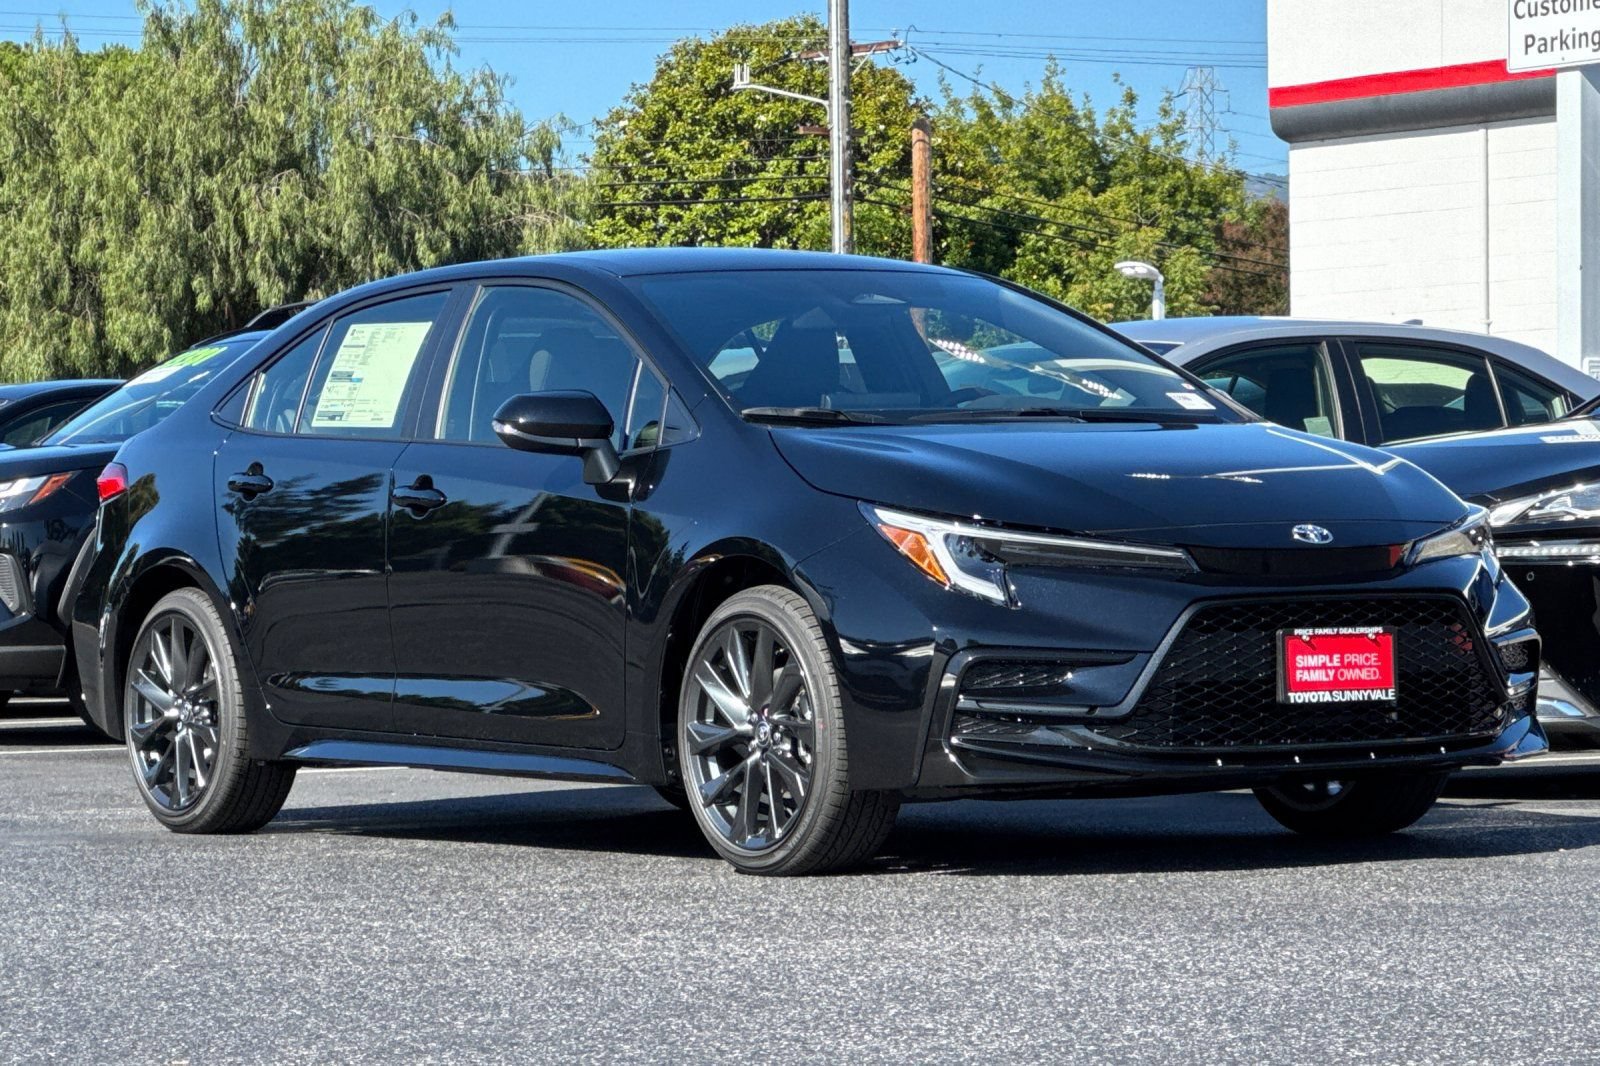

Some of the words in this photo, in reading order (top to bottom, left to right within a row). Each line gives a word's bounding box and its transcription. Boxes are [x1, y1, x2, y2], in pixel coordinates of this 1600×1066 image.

[1524, 27, 1600, 55] Parking
[1294, 628, 1314, 636] PRICE
[1315, 627, 1338, 635] FAMILY
[1339, 626, 1384, 635] DEALERSHIPS
[1296, 654, 1341, 667] SIMPLE
[1344, 653, 1382, 666] PRICE.
[1296, 669, 1336, 682] FAMILY
[1337, 668, 1382, 681] OWNED.
[1288, 691, 1333, 703] TOYOTA
[1332, 689, 1396, 702] SUNNYVALE
